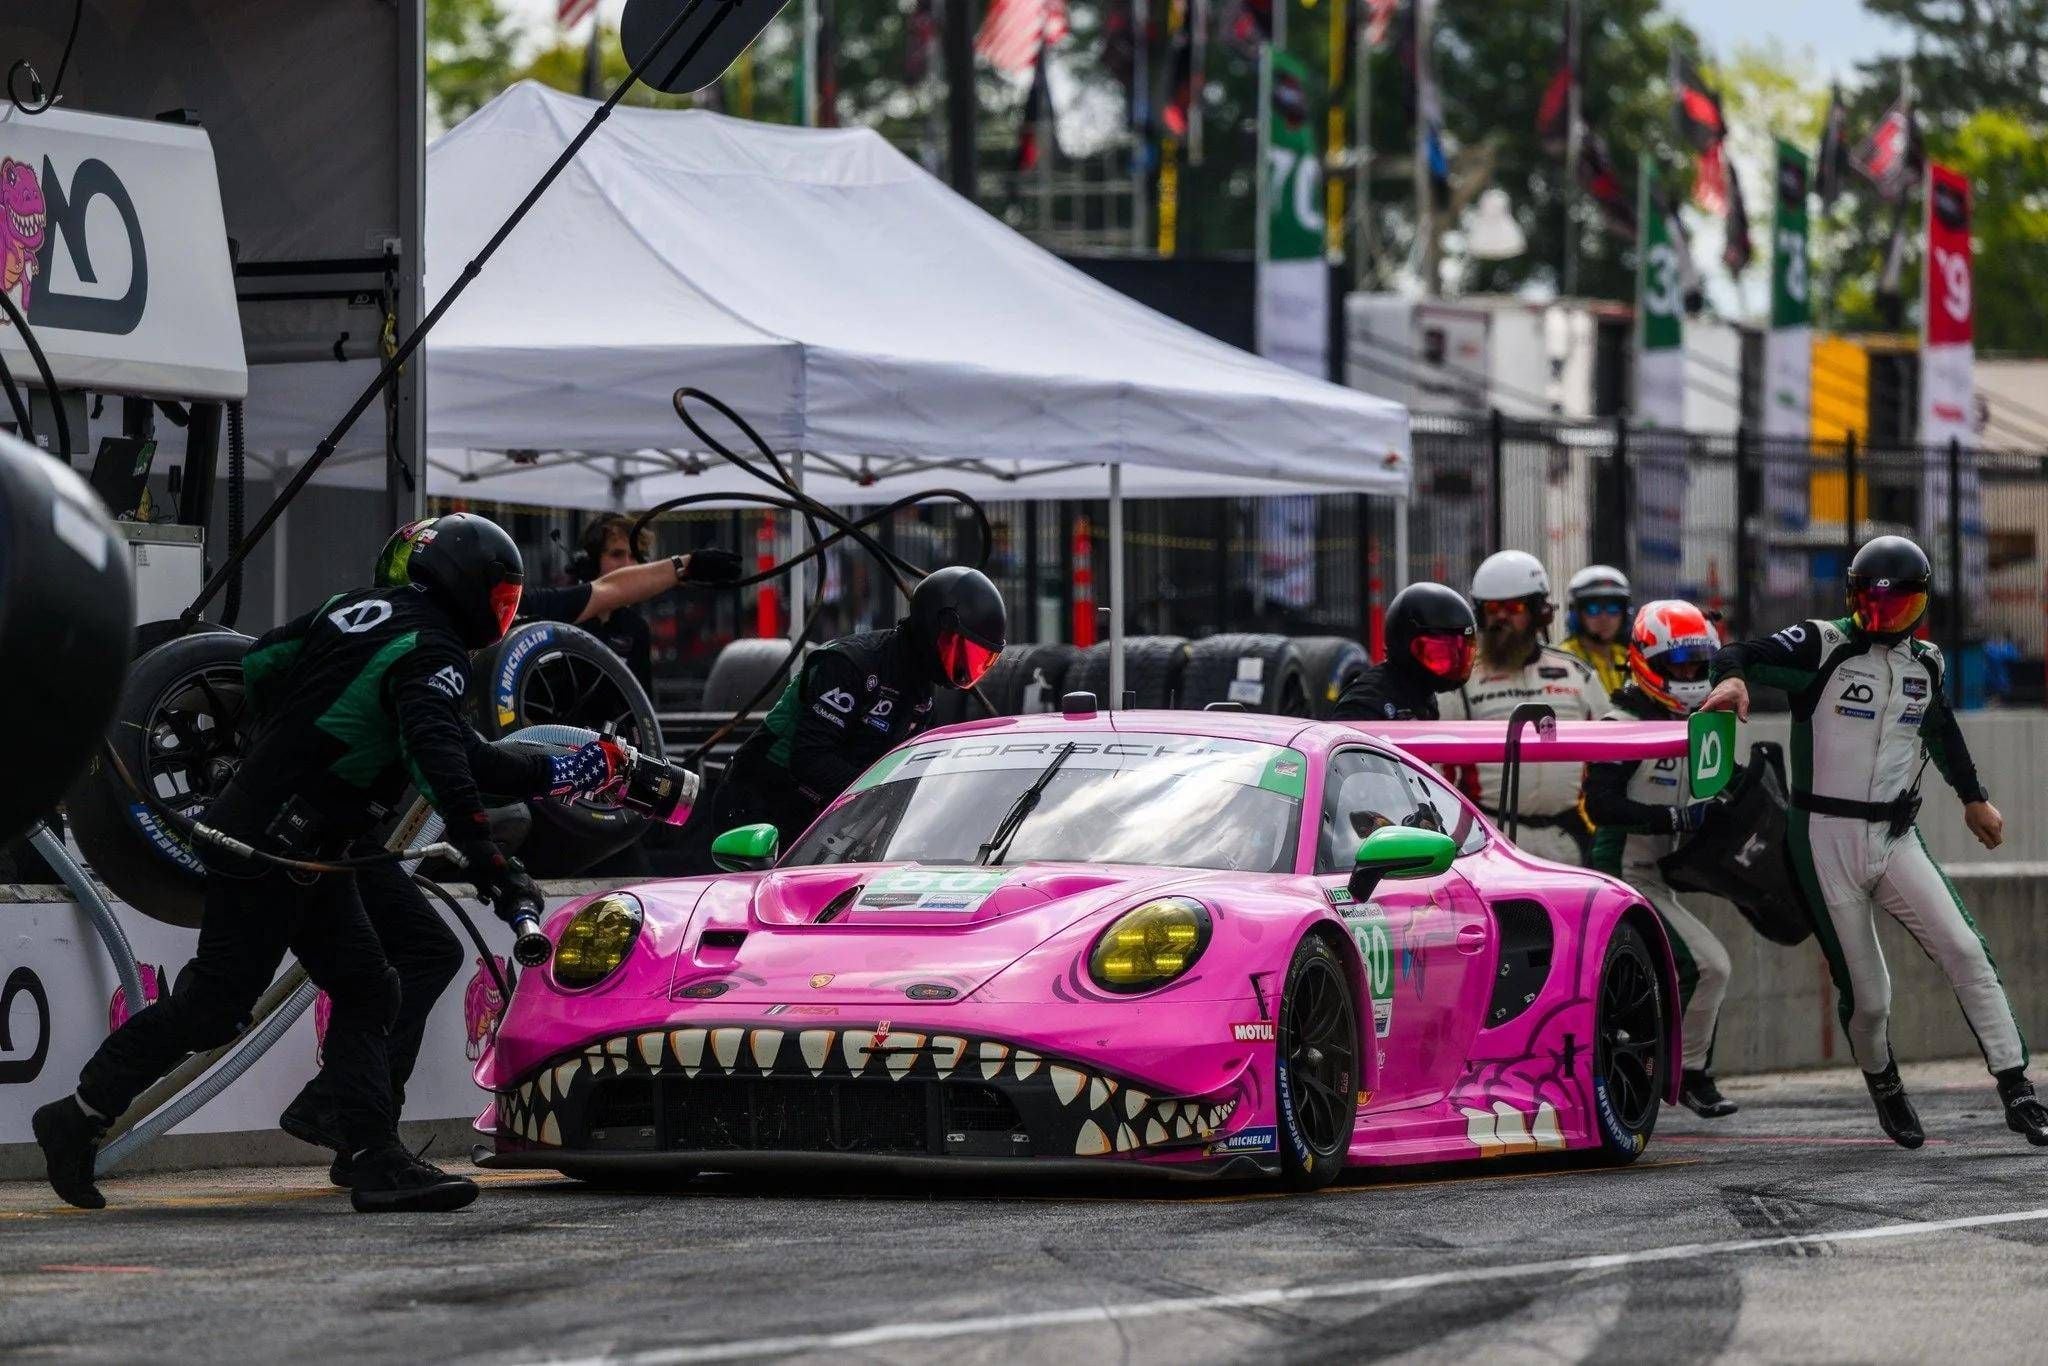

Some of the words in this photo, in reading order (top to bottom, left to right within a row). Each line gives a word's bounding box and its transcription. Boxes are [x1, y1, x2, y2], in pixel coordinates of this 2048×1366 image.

[501, 630, 548, 691] MICHELIN
[1470, 684, 1582, 705] WeatherTech
[1334, 889, 1351, 900] GTD
[1354, 926, 1389, 995] 80
[1234, 1025, 1274, 1040] MOTUL
[1279, 1066, 1304, 1151] MICHELIN
[1597, 1086, 1632, 1150] MICHELIN
[1229, 1135, 1271, 1148] MICHELIN
